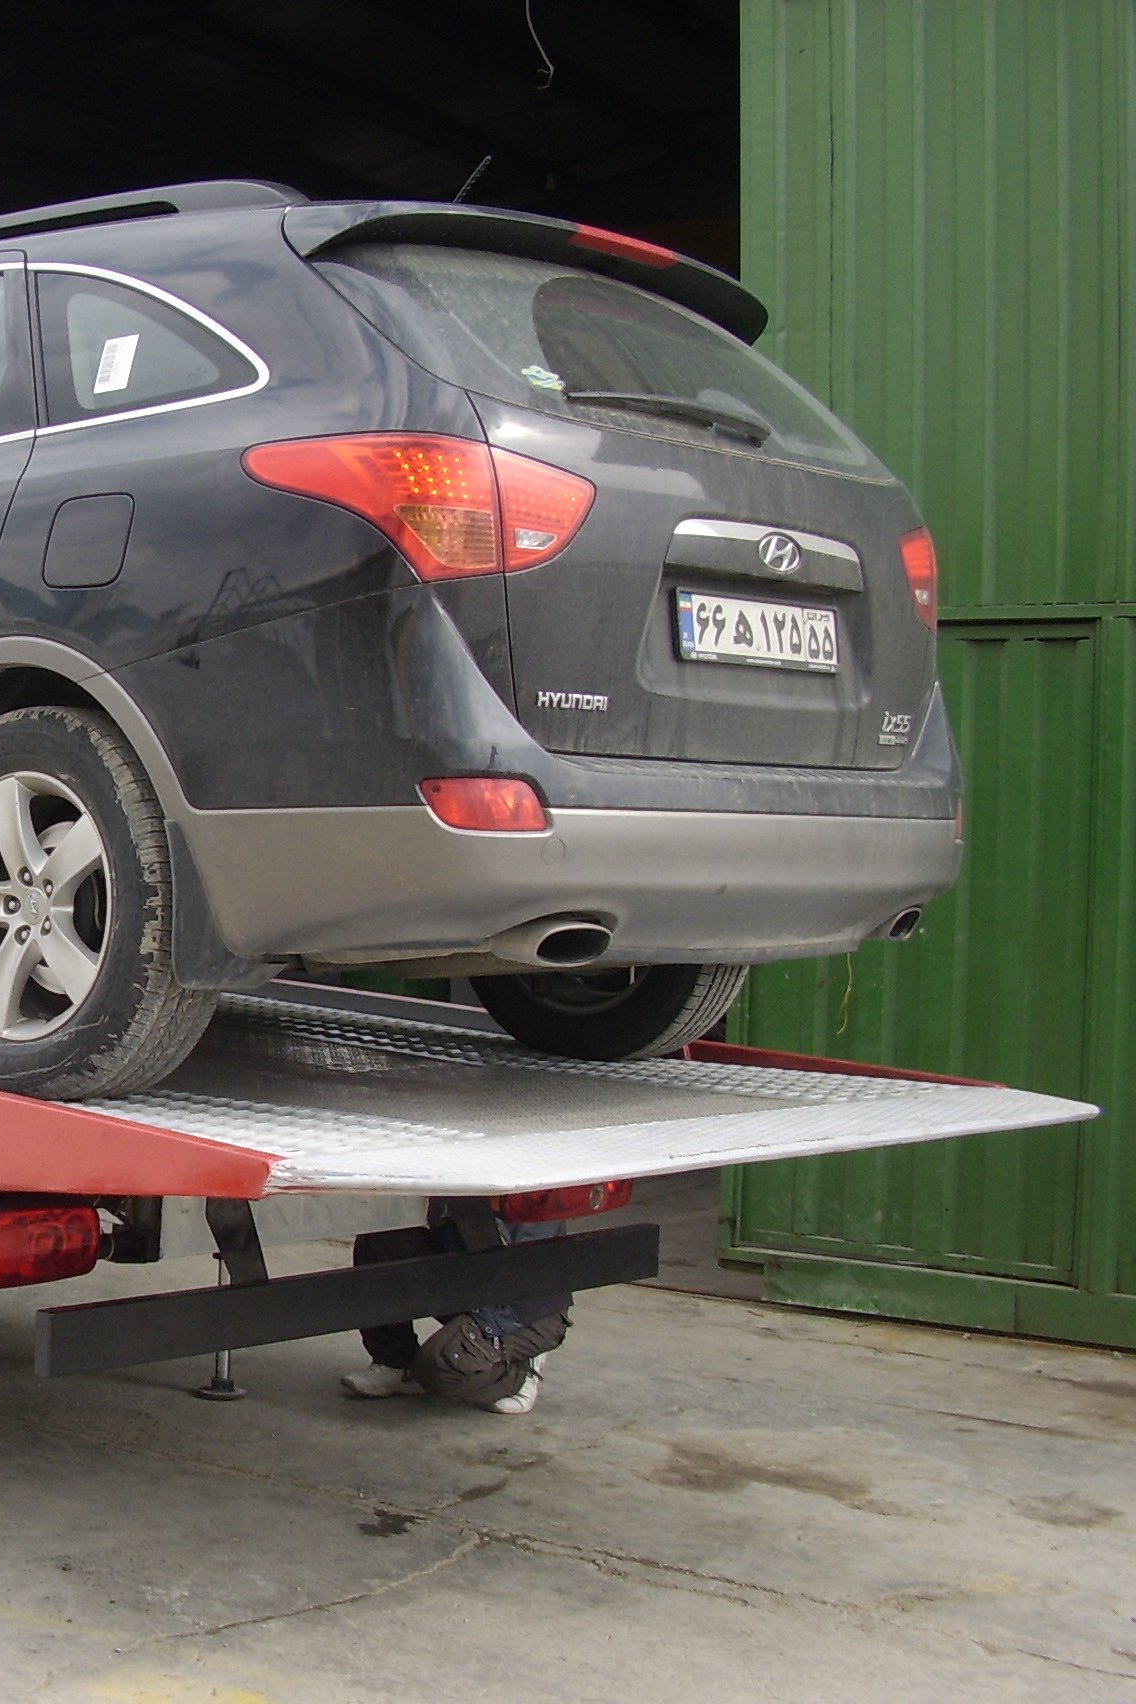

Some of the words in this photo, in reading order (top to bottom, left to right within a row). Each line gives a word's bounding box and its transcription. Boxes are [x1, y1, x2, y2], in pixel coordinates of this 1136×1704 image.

[696, 602, 726, 647] ۶۶
[760, 610, 802, 655] ۱۲۵
[807, 624, 834, 661] ۵۵
[537, 691, 608, 711] HYUNDAI
[882, 710, 912, 733] ix55
